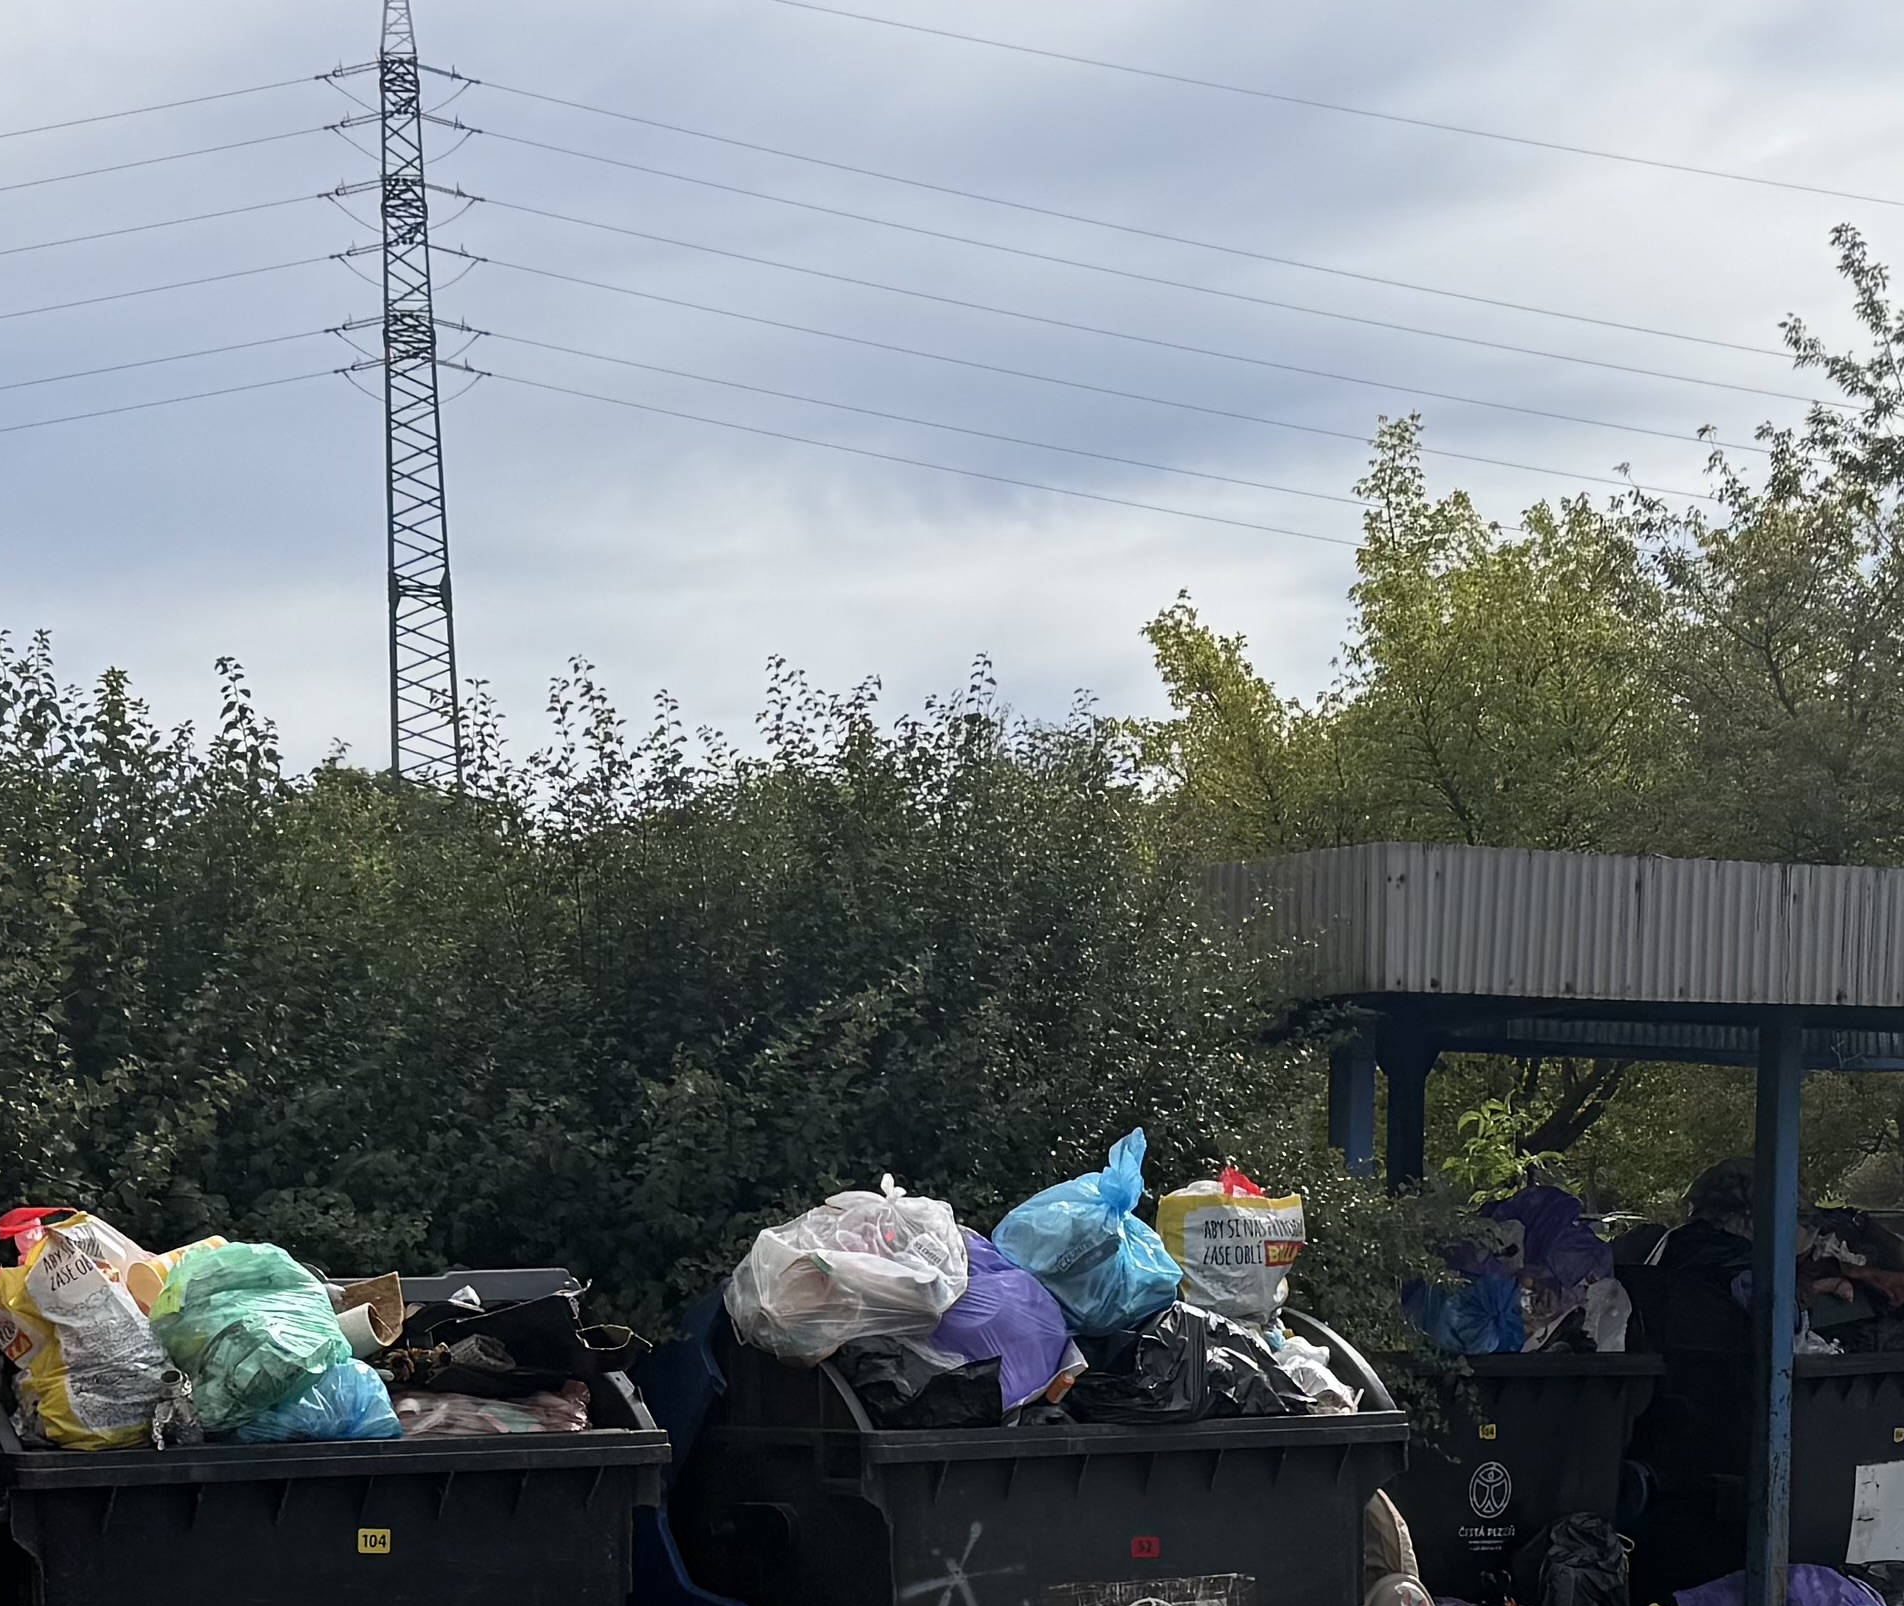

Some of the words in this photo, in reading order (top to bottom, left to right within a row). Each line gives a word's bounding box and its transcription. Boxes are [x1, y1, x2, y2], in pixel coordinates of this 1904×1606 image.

[1204, 1219, 1224, 1239] ABY
[1227, 1218, 1242, 1238] SI
[1202, 1245, 1232, 1266] ZASE
[362, 1534, 387, 1548] 104
